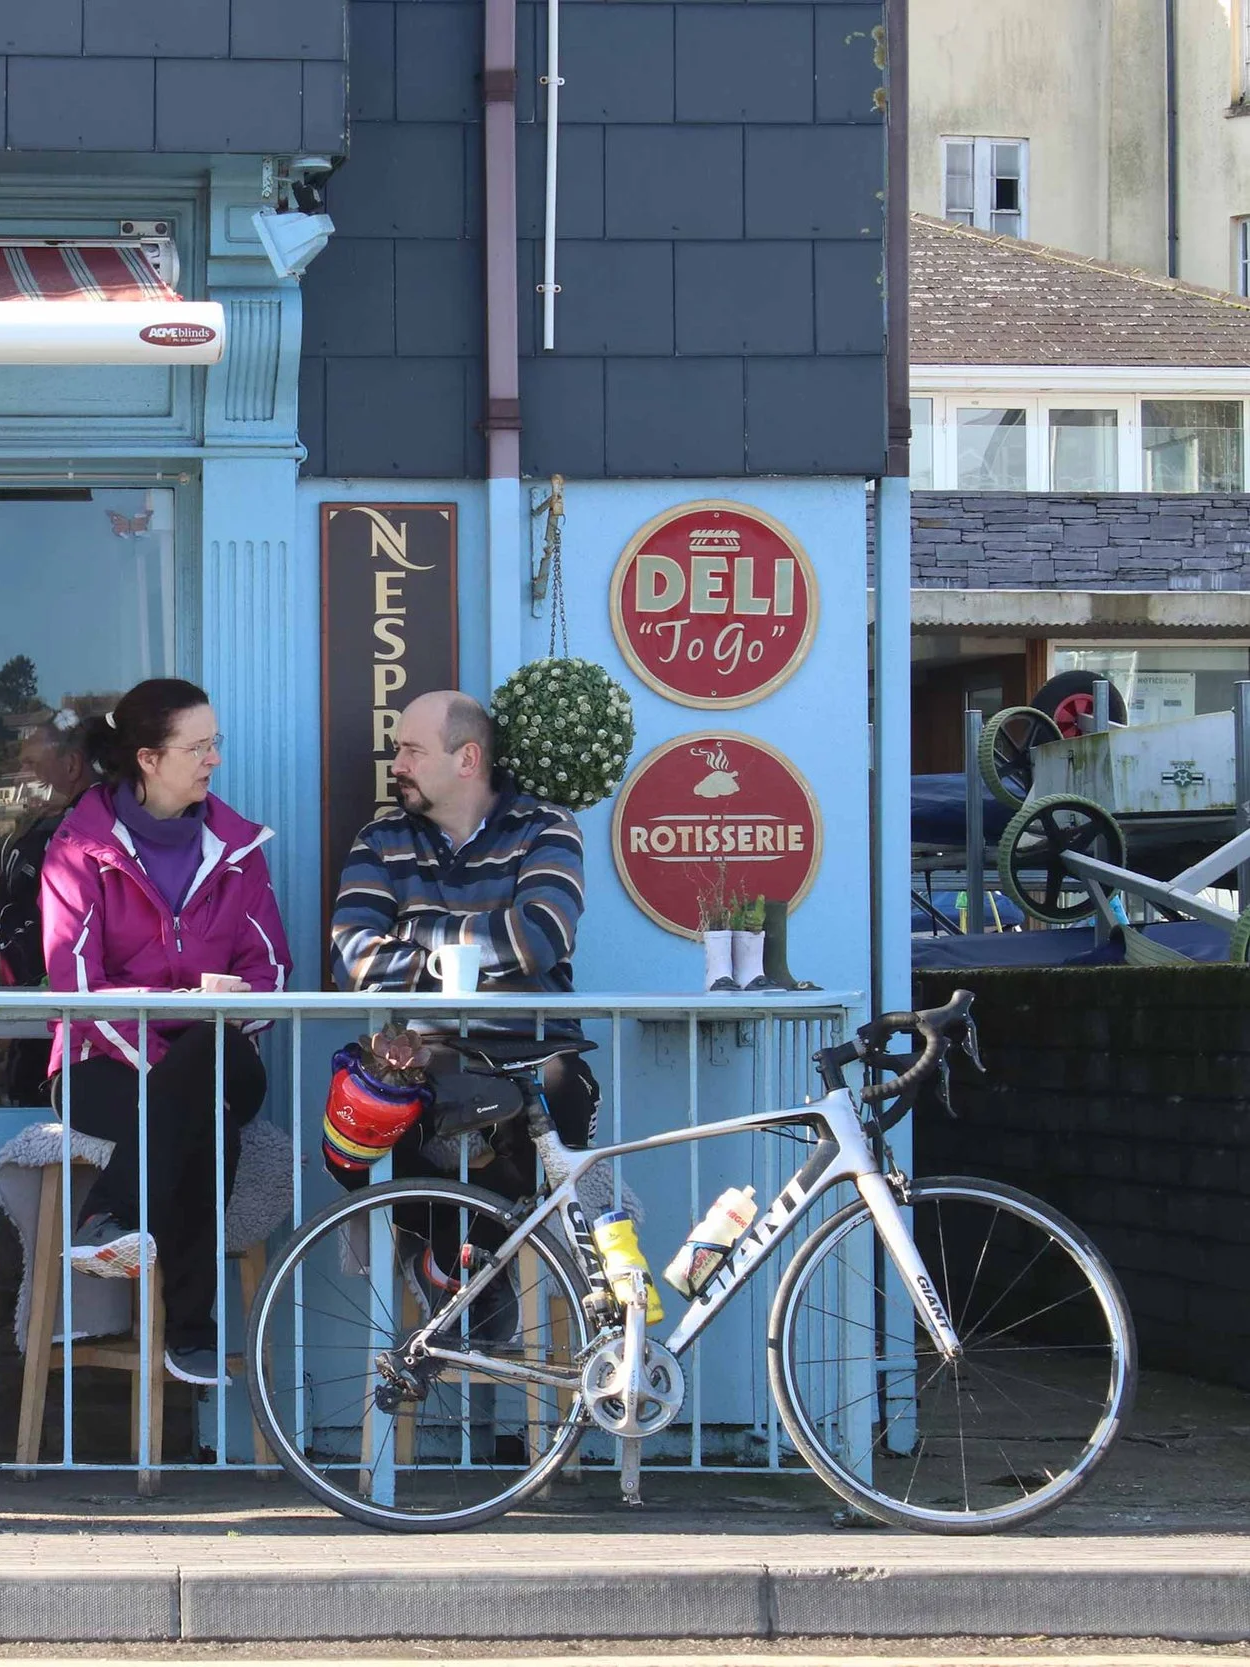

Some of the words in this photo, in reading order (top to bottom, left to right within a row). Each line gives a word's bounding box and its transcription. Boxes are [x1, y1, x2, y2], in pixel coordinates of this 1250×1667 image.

[635, 554, 795, 617] DELI
[630, 825, 805, 853] ROTISSERIE
[916, 1274, 952, 1332] GIANT
